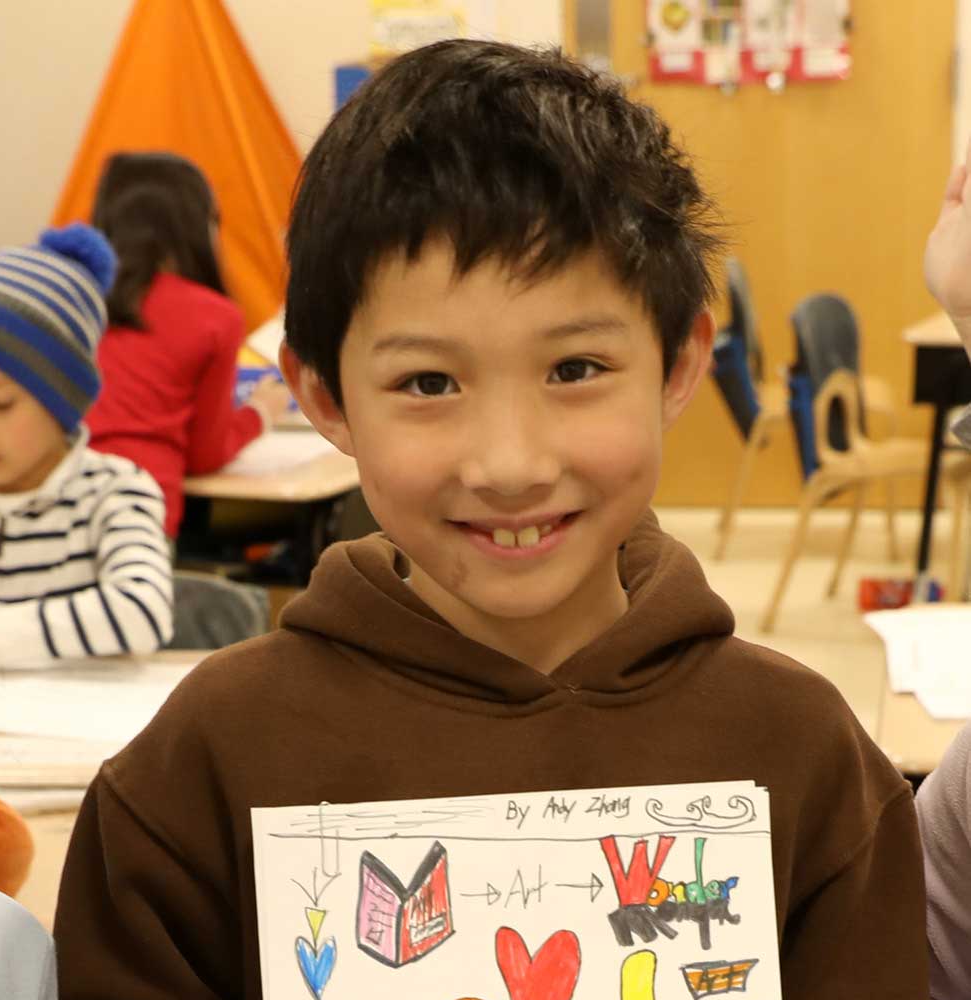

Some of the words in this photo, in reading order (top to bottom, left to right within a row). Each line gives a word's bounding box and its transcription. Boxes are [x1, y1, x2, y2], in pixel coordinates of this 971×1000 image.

[506, 800, 531, 829] By
[542, 796, 577, 823] Andy
[585, 794, 631, 819] Zhang
[504, 863, 548, 910] Art
